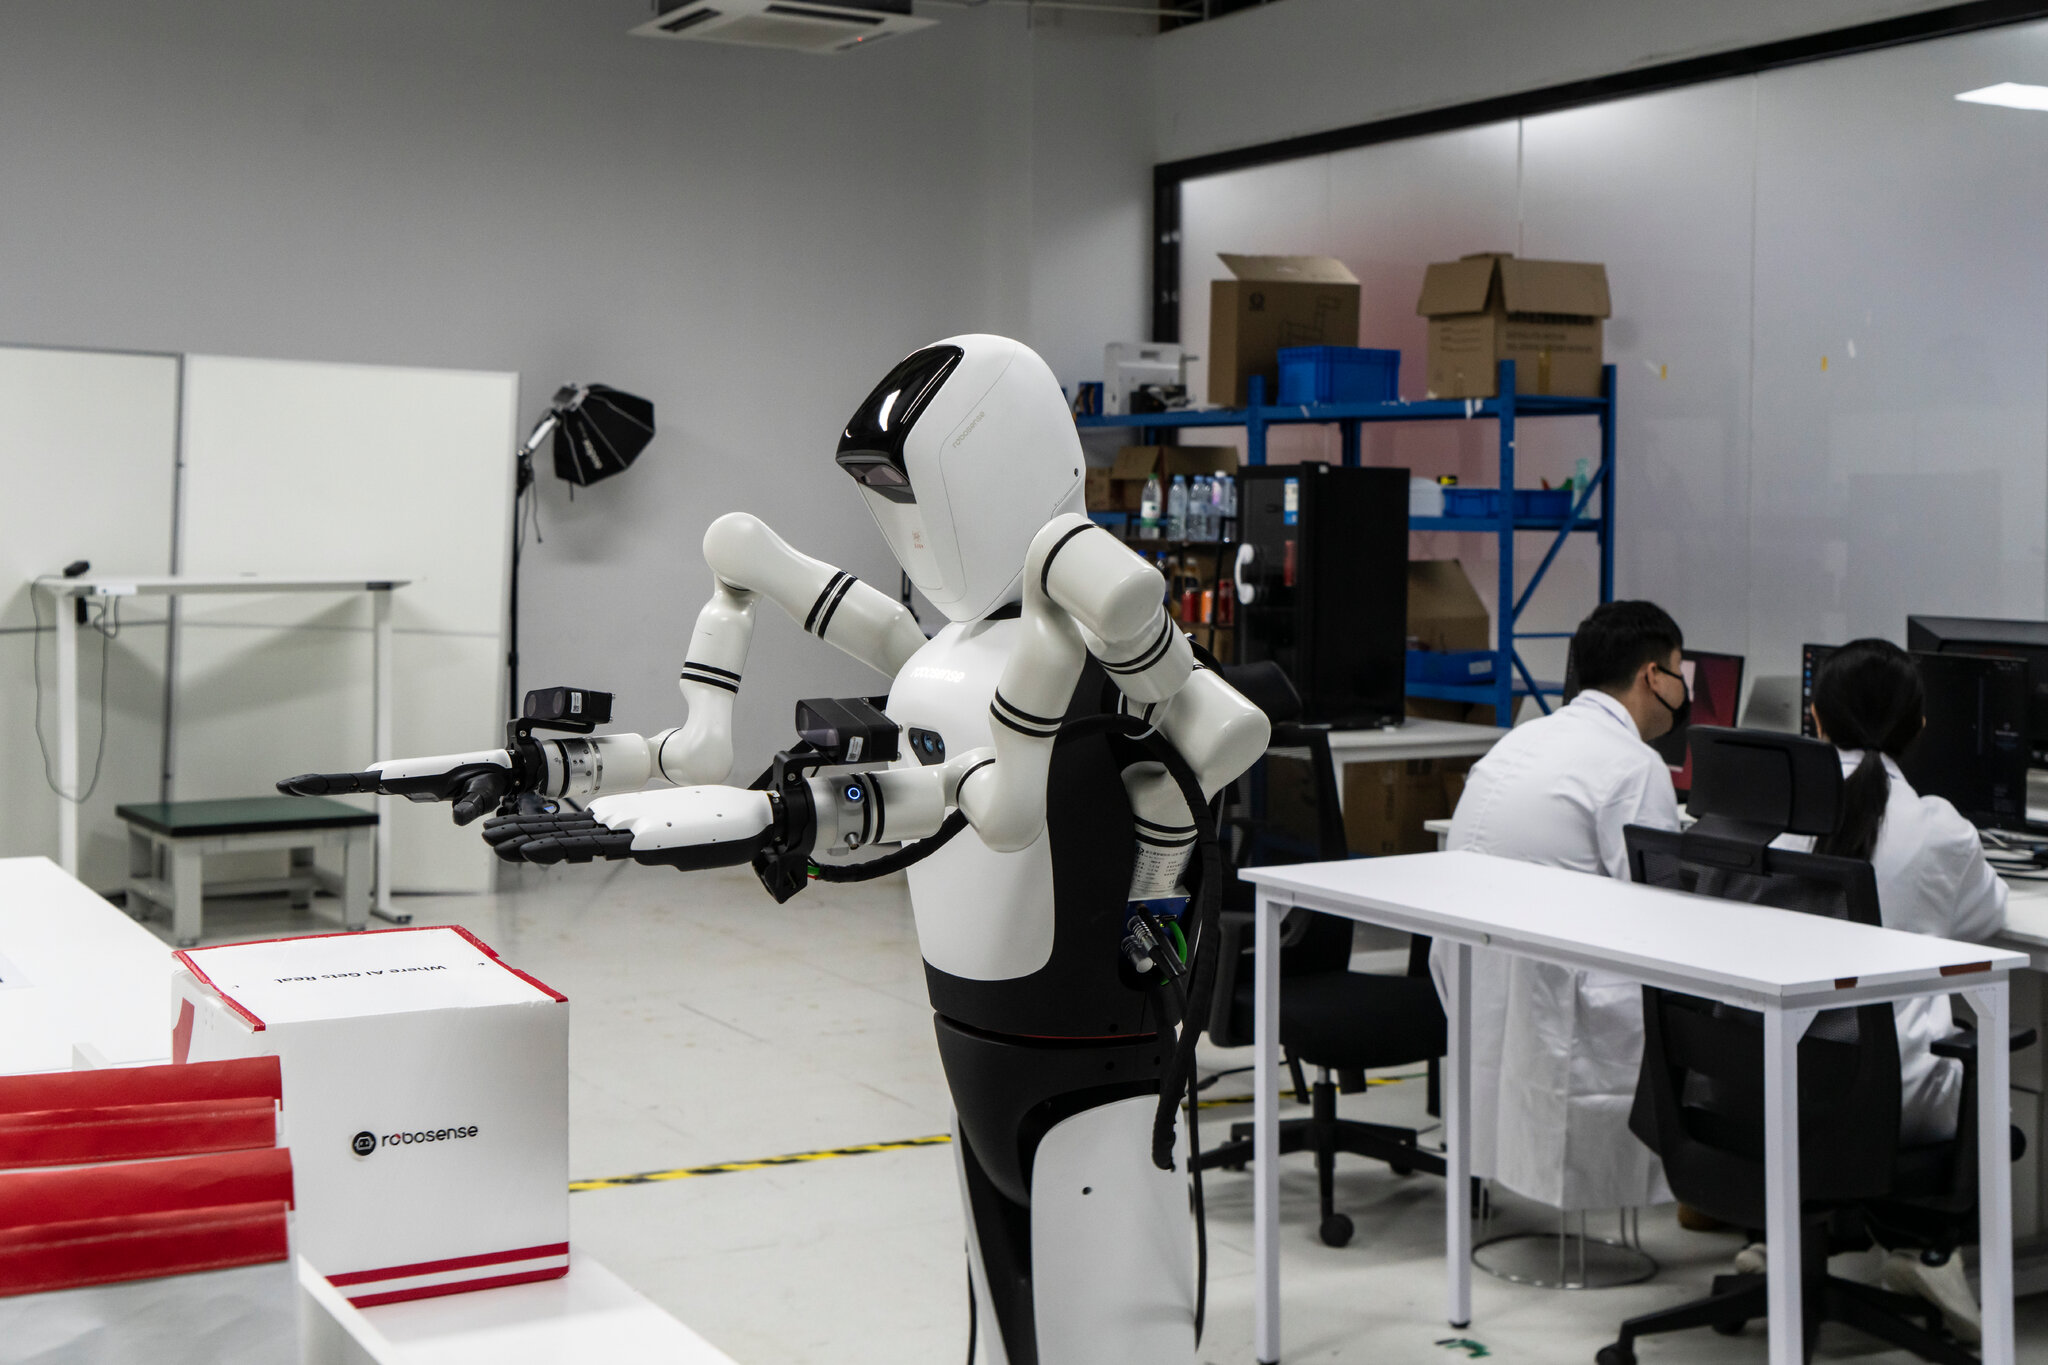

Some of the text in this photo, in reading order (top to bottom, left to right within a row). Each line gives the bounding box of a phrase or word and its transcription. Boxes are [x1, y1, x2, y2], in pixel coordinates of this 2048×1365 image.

[388, 964, 447, 974] Where
[274, 975, 317, 984] Real
[381, 1125, 478, 1147] robosense
